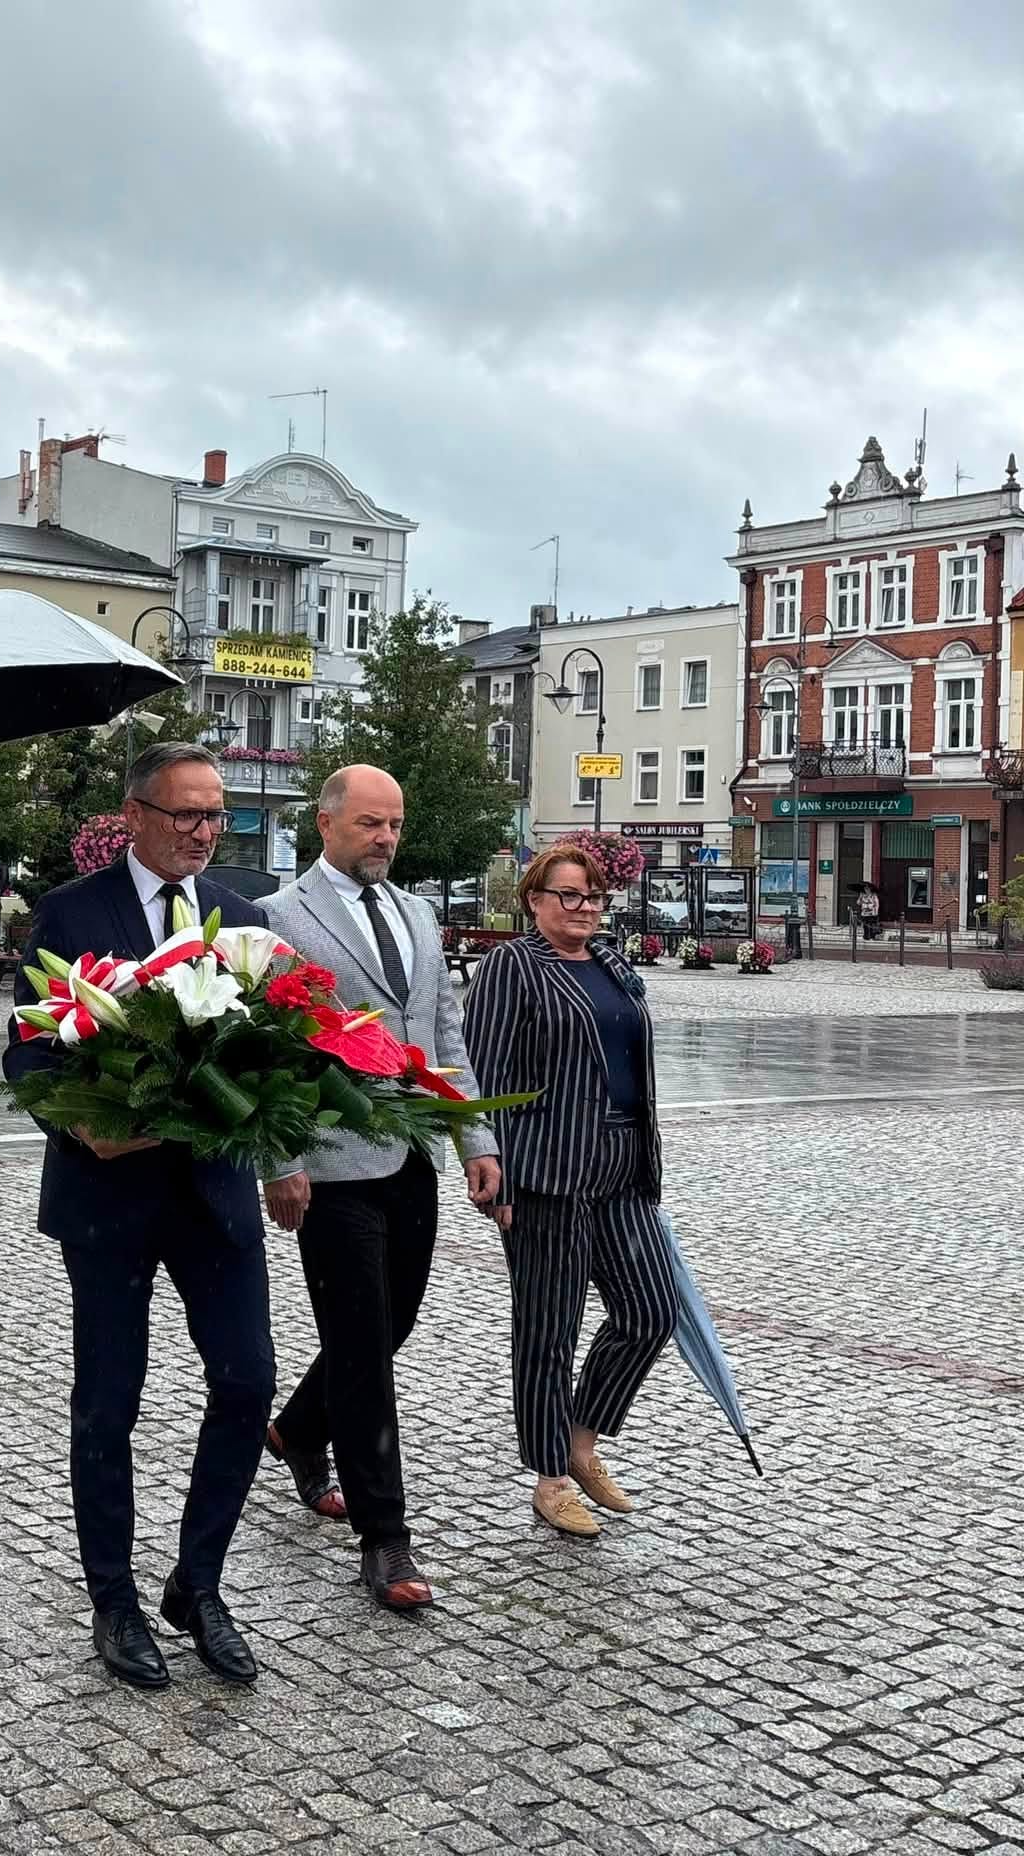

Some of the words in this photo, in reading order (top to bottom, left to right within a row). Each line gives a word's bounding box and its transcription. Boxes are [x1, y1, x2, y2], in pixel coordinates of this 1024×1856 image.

[216, 641, 263, 658] SPRZEDAM
[266, 647, 312, 664] KAMIENICĘ
[222, 659, 306, 679] 888-244-644
